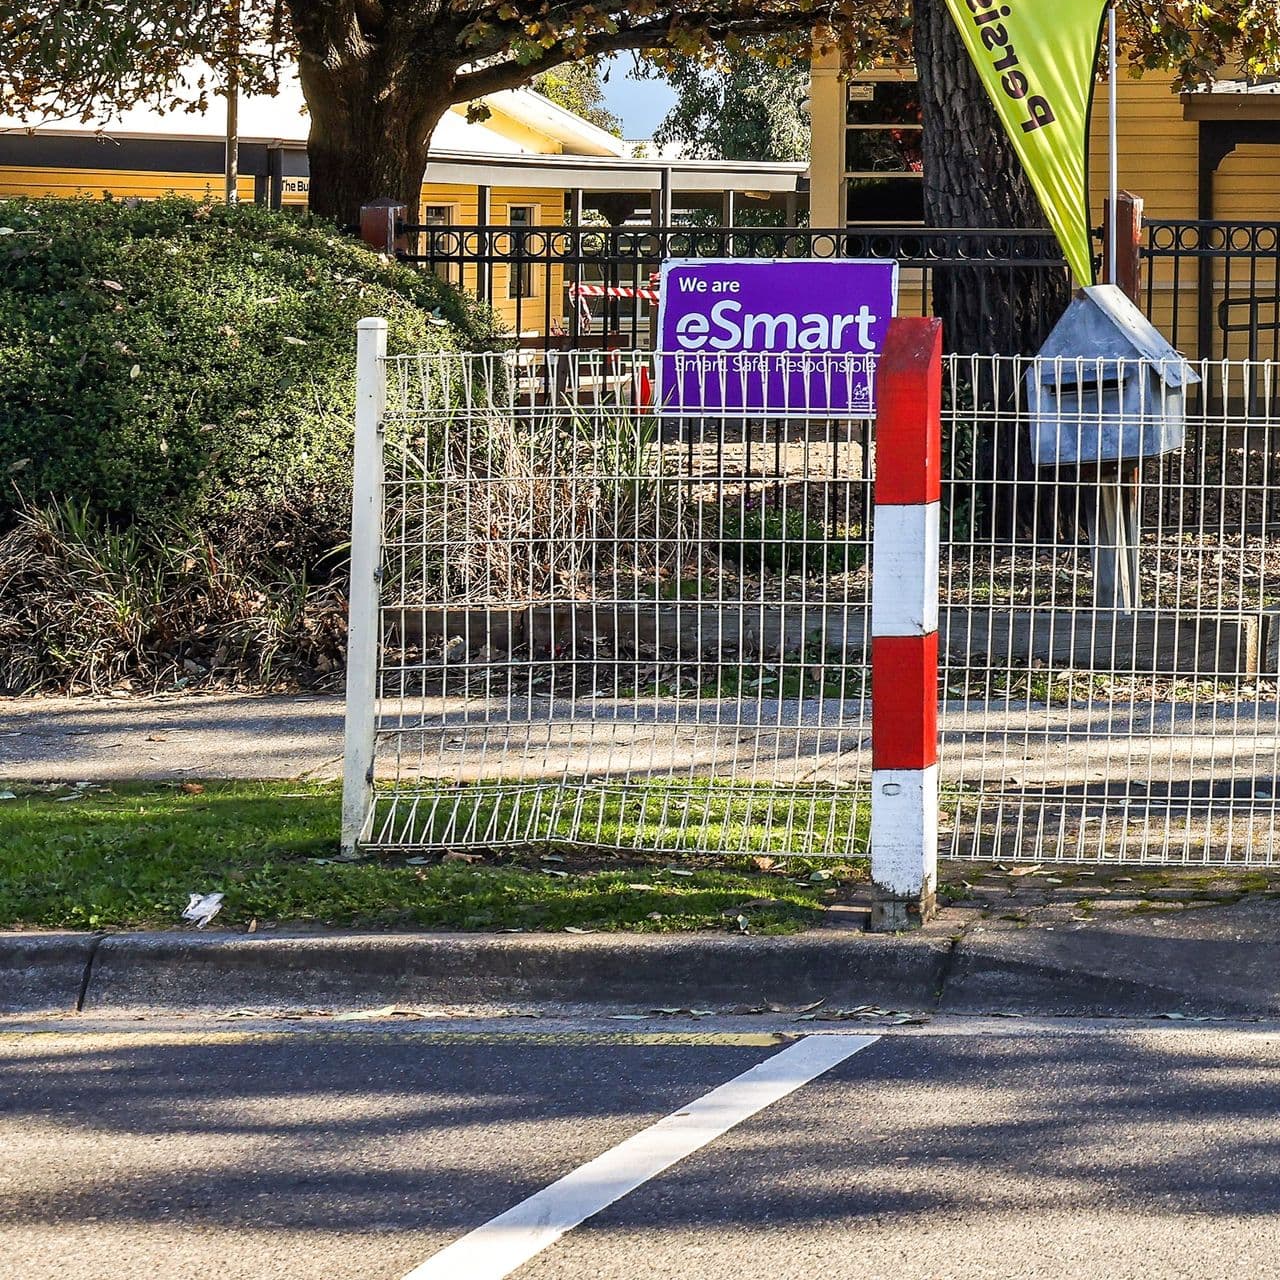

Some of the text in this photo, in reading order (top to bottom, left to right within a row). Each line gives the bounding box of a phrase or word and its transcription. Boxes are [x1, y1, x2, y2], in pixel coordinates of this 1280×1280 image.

[297, 181, 309, 192] Bu
[678, 277, 741, 293] We are
[675, 299, 877, 351] eSmart
